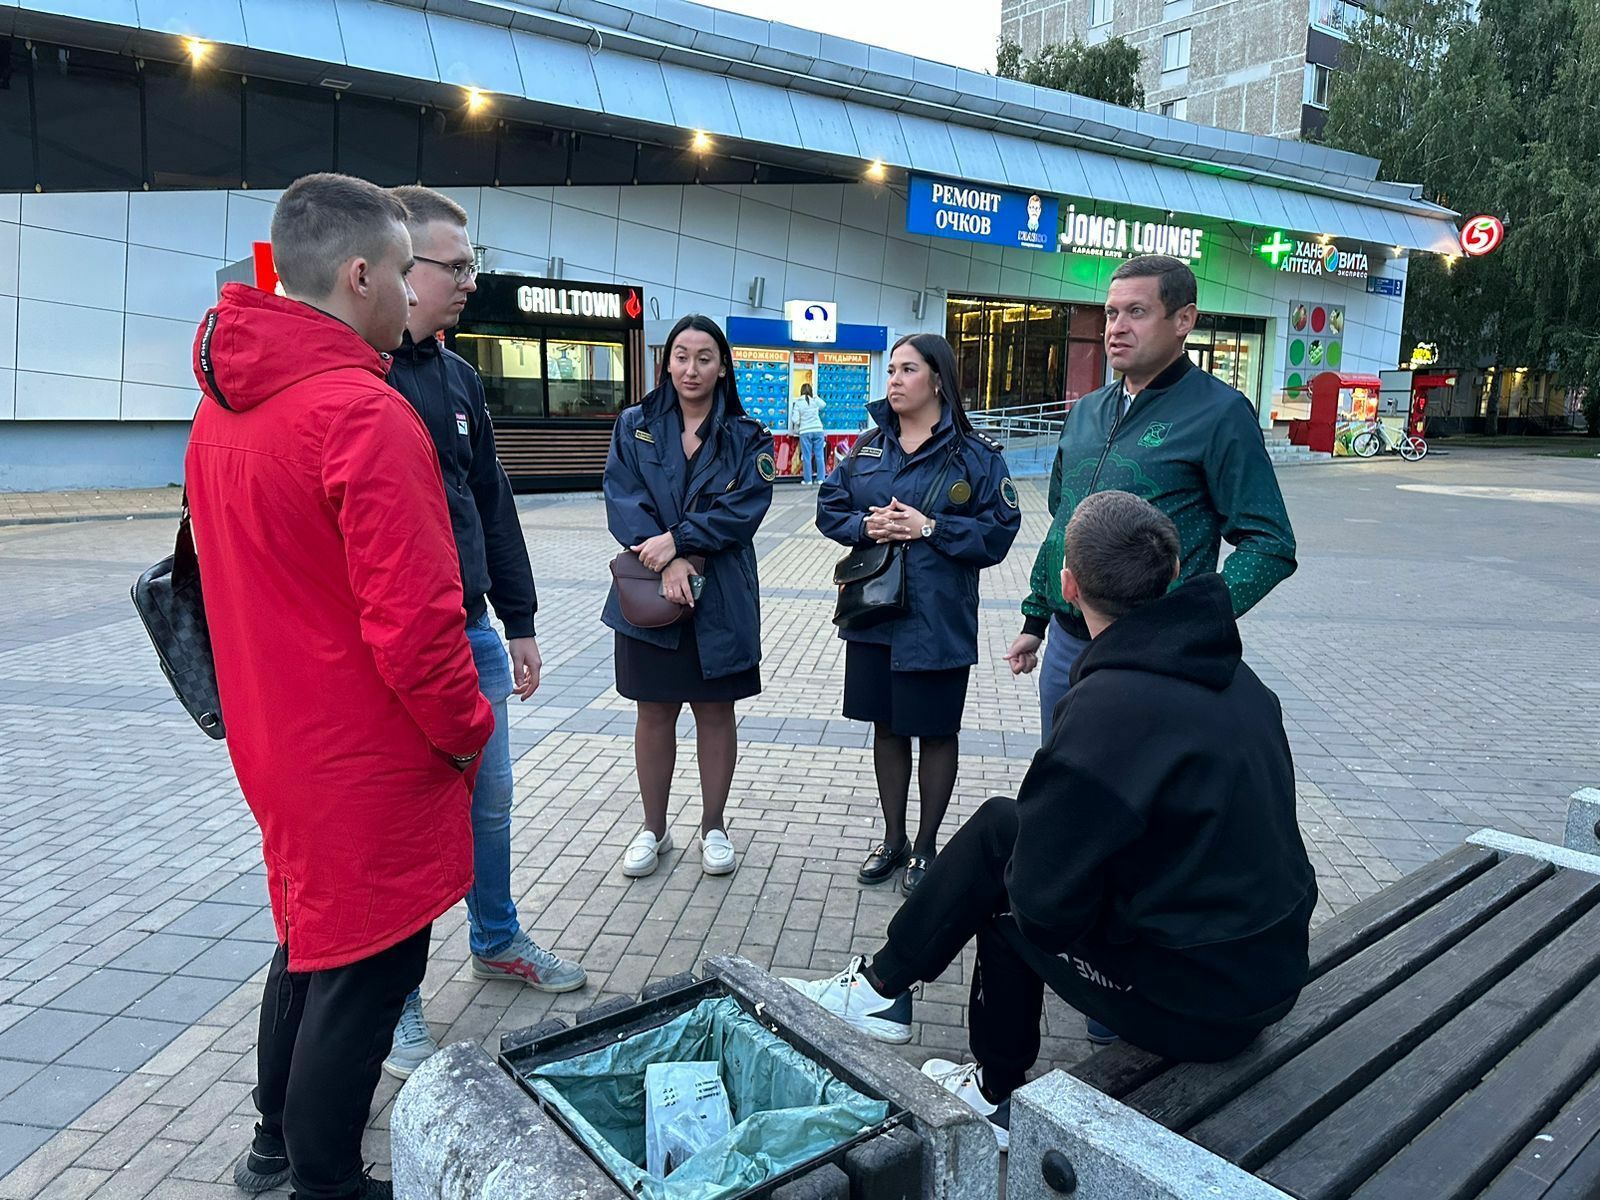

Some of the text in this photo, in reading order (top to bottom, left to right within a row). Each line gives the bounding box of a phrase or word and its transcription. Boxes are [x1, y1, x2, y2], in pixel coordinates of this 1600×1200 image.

[932, 183, 1001, 213] РЕМОНТ
[935, 209, 991, 235] ОЧКОВ
[1133, 221, 1203, 258] LOUNGE
[1280, 257, 1322, 276] АПТЕКА
[1338, 252, 1368, 271] ВИТА
[1337, 270, 1368, 279] ЭКСПРЕСС
[517, 285, 620, 319] GRILLTOWN
[735, 350, 784, 361] МОРОЖЕНОЕ
[823, 353, 863, 363] ТУНДЫРМА
